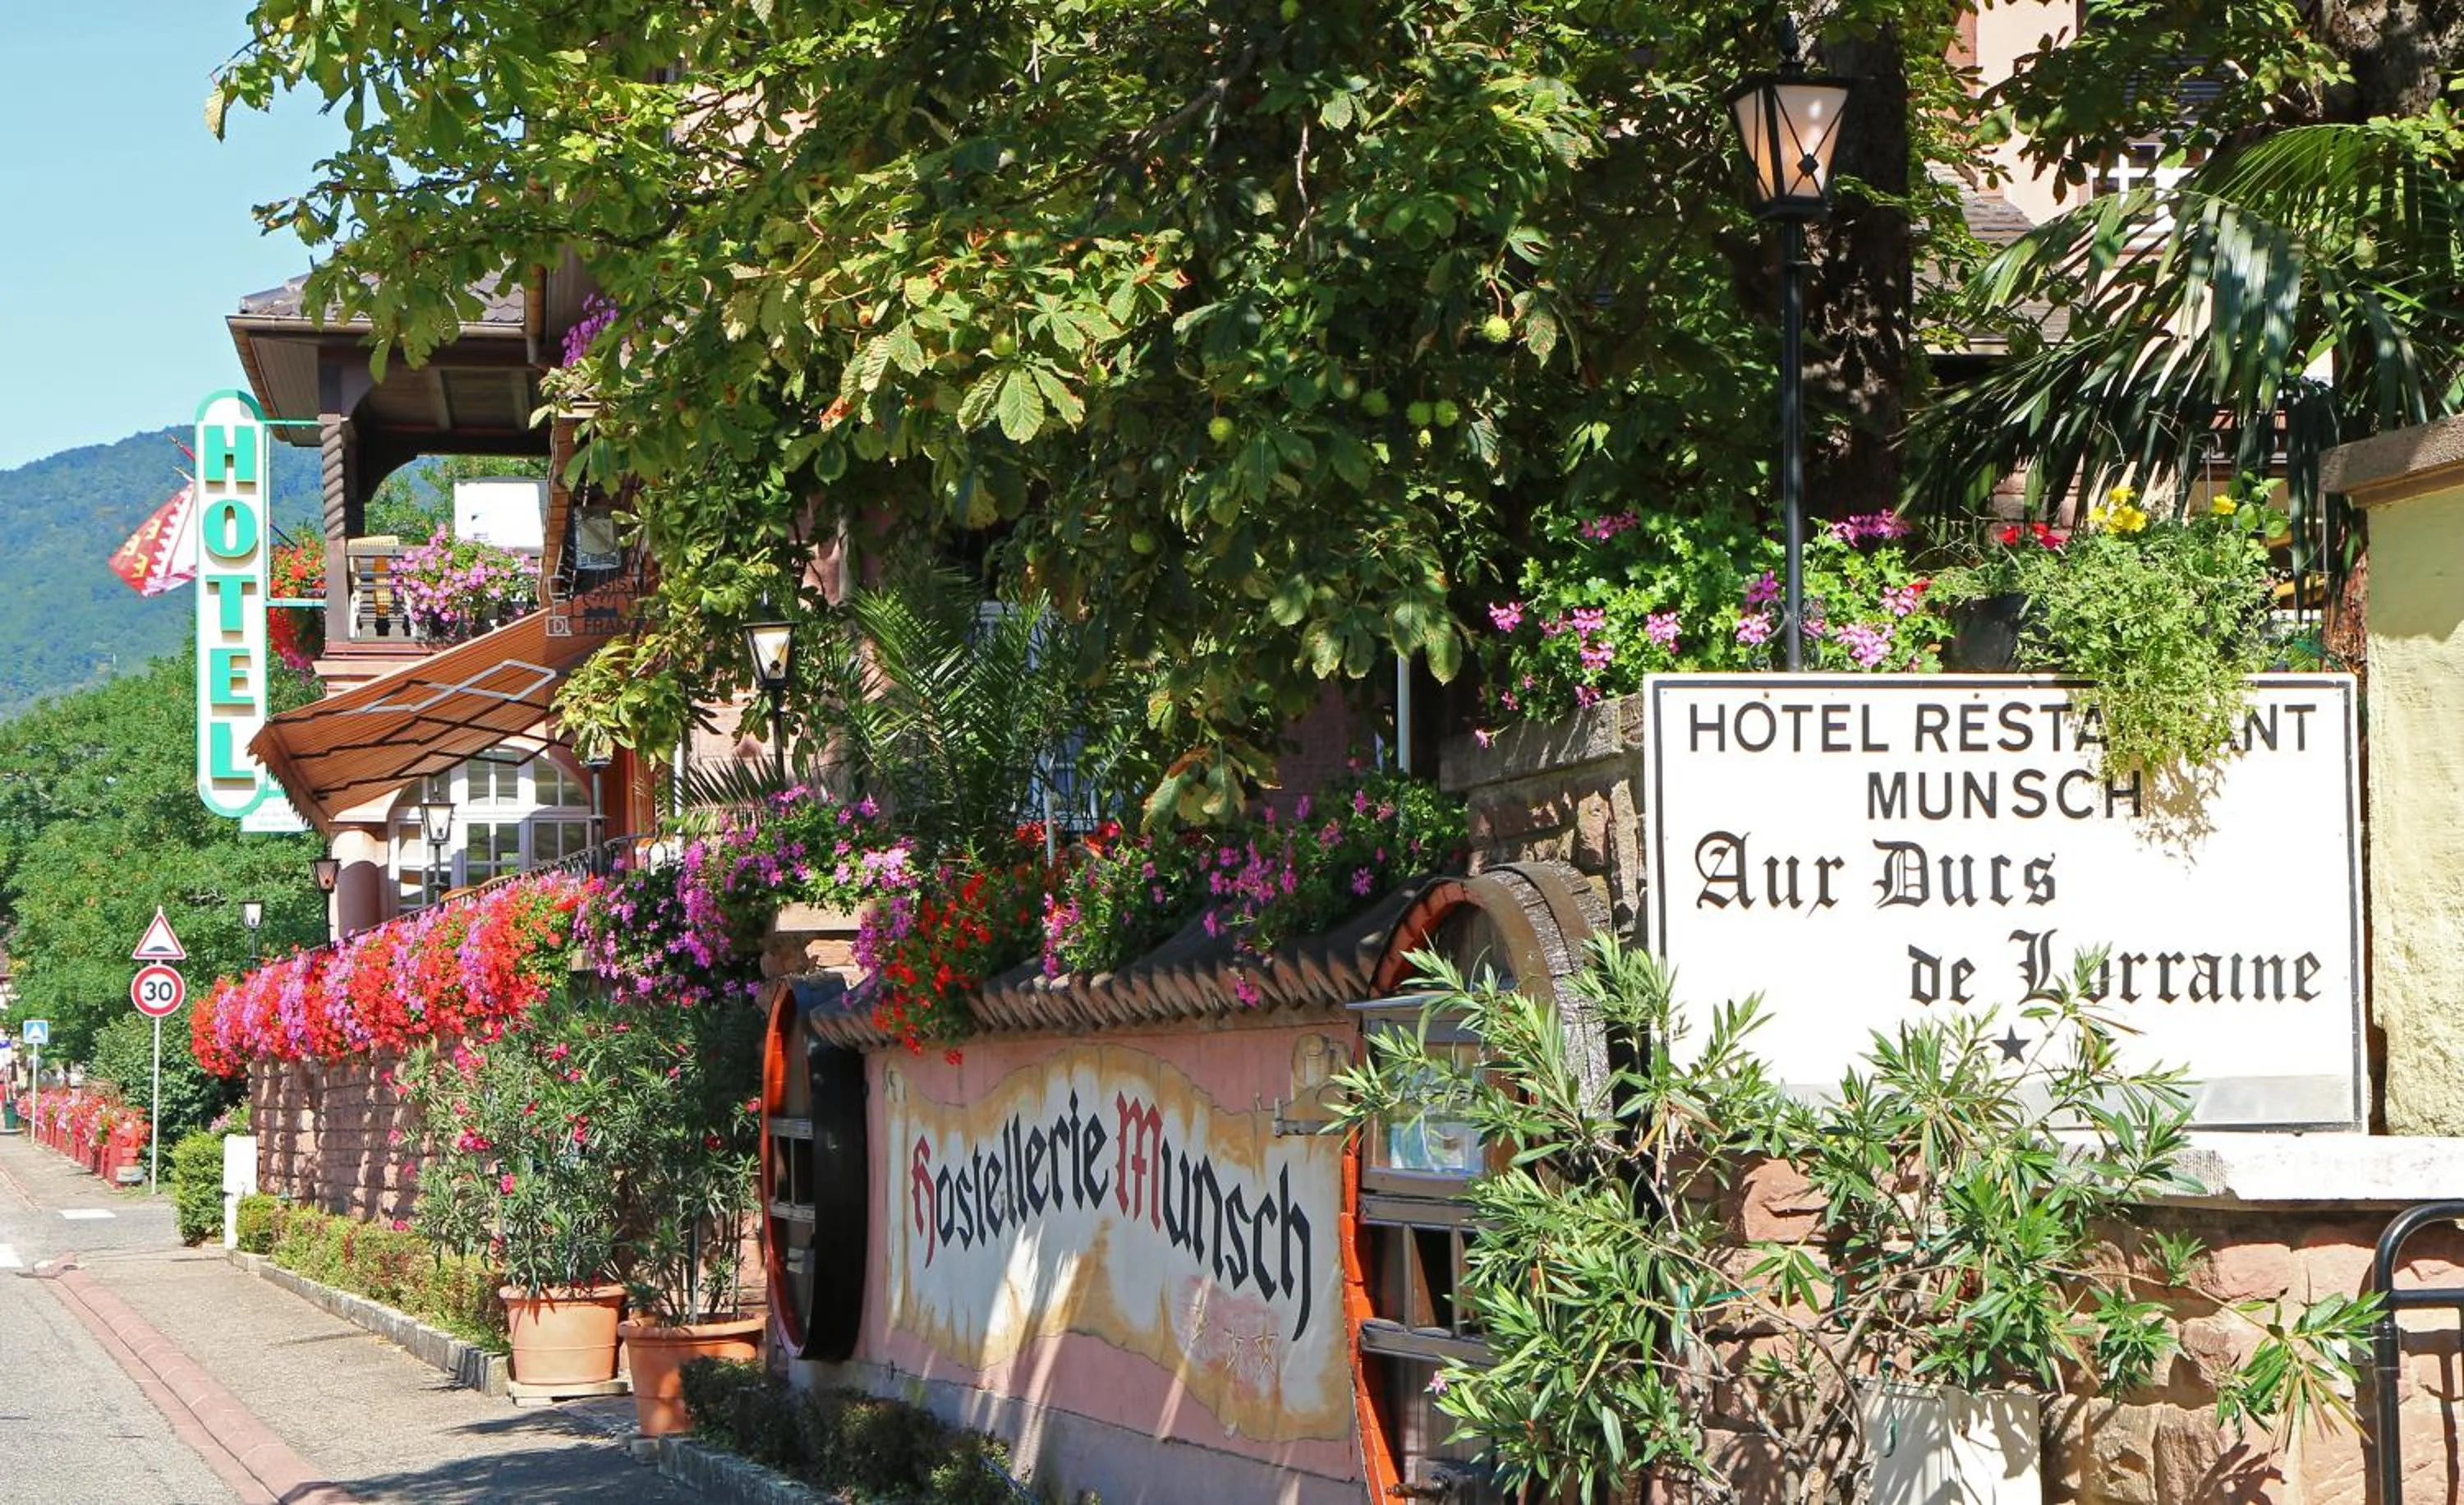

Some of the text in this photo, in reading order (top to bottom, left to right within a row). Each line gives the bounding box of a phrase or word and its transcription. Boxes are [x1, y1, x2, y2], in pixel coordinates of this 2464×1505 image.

[203, 425, 257, 780] HOTEL
[1689, 701, 2317, 753] HOTEL RESTANT
[1868, 768, 2141, 820] MUNSCH
[1694, 830, 2056, 918] Aux Ducs
[144, 980, 173, 1001] 30
[1907, 943, 1976, 1006] de
[910, 1087, 1312, 1342] Hostellerie Munsch
